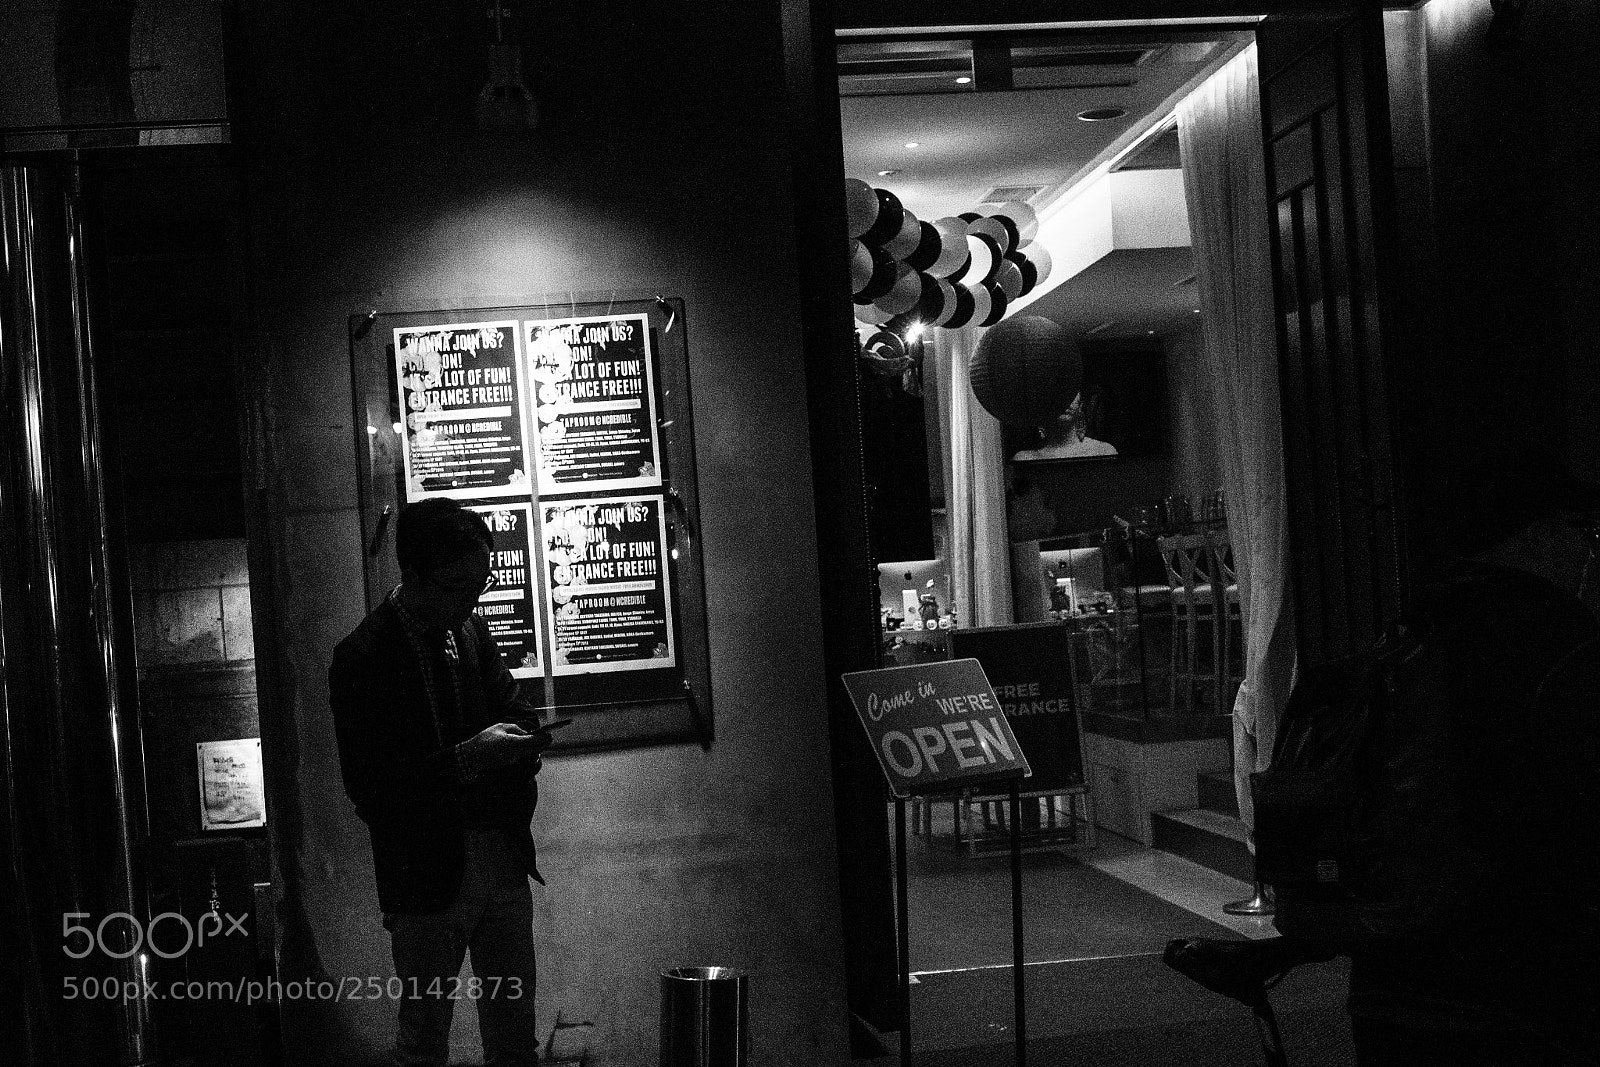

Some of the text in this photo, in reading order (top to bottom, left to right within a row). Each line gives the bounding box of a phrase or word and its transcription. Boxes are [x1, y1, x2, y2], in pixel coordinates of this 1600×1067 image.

[452, 333, 480, 351] JOIN
[481, 331, 504, 349] US?
[583, 326, 610, 344] JOIN
[612, 325, 634, 342] US?
[442, 353, 463, 369] ON!
[572, 346, 593, 362] ON!
[444, 370, 465, 387] LOT
[467, 369, 482, 385] OF
[484, 367, 511, 384] FUN!
[574, 360, 641, 380] LOT OF FUN!
[410, 385, 513, 408] ENTRANCE FREE!!!
[550, 378, 642, 399] TRANCE FREE!!!
[495, 514, 517, 532] US?
[598, 508, 625, 525] JOIN
[627, 506, 649, 522] US?
[587, 527, 608, 543] ON!
[497, 549, 525, 567] FUN!
[589, 543, 610, 561] LOT
[613, 543, 626, 559] OF
[629, 541, 656, 558] FUN!
[491, 568, 526, 586] REE!!!
[617, 559, 657, 578] FREE!!!
[993, 682, 1041, 699] FREE
[867, 680, 937, 722] Come in
[936, 692, 994, 716] WE'RE
[1000, 698, 1070, 717] RANCE
[881, 717, 1015, 778] OPEN
